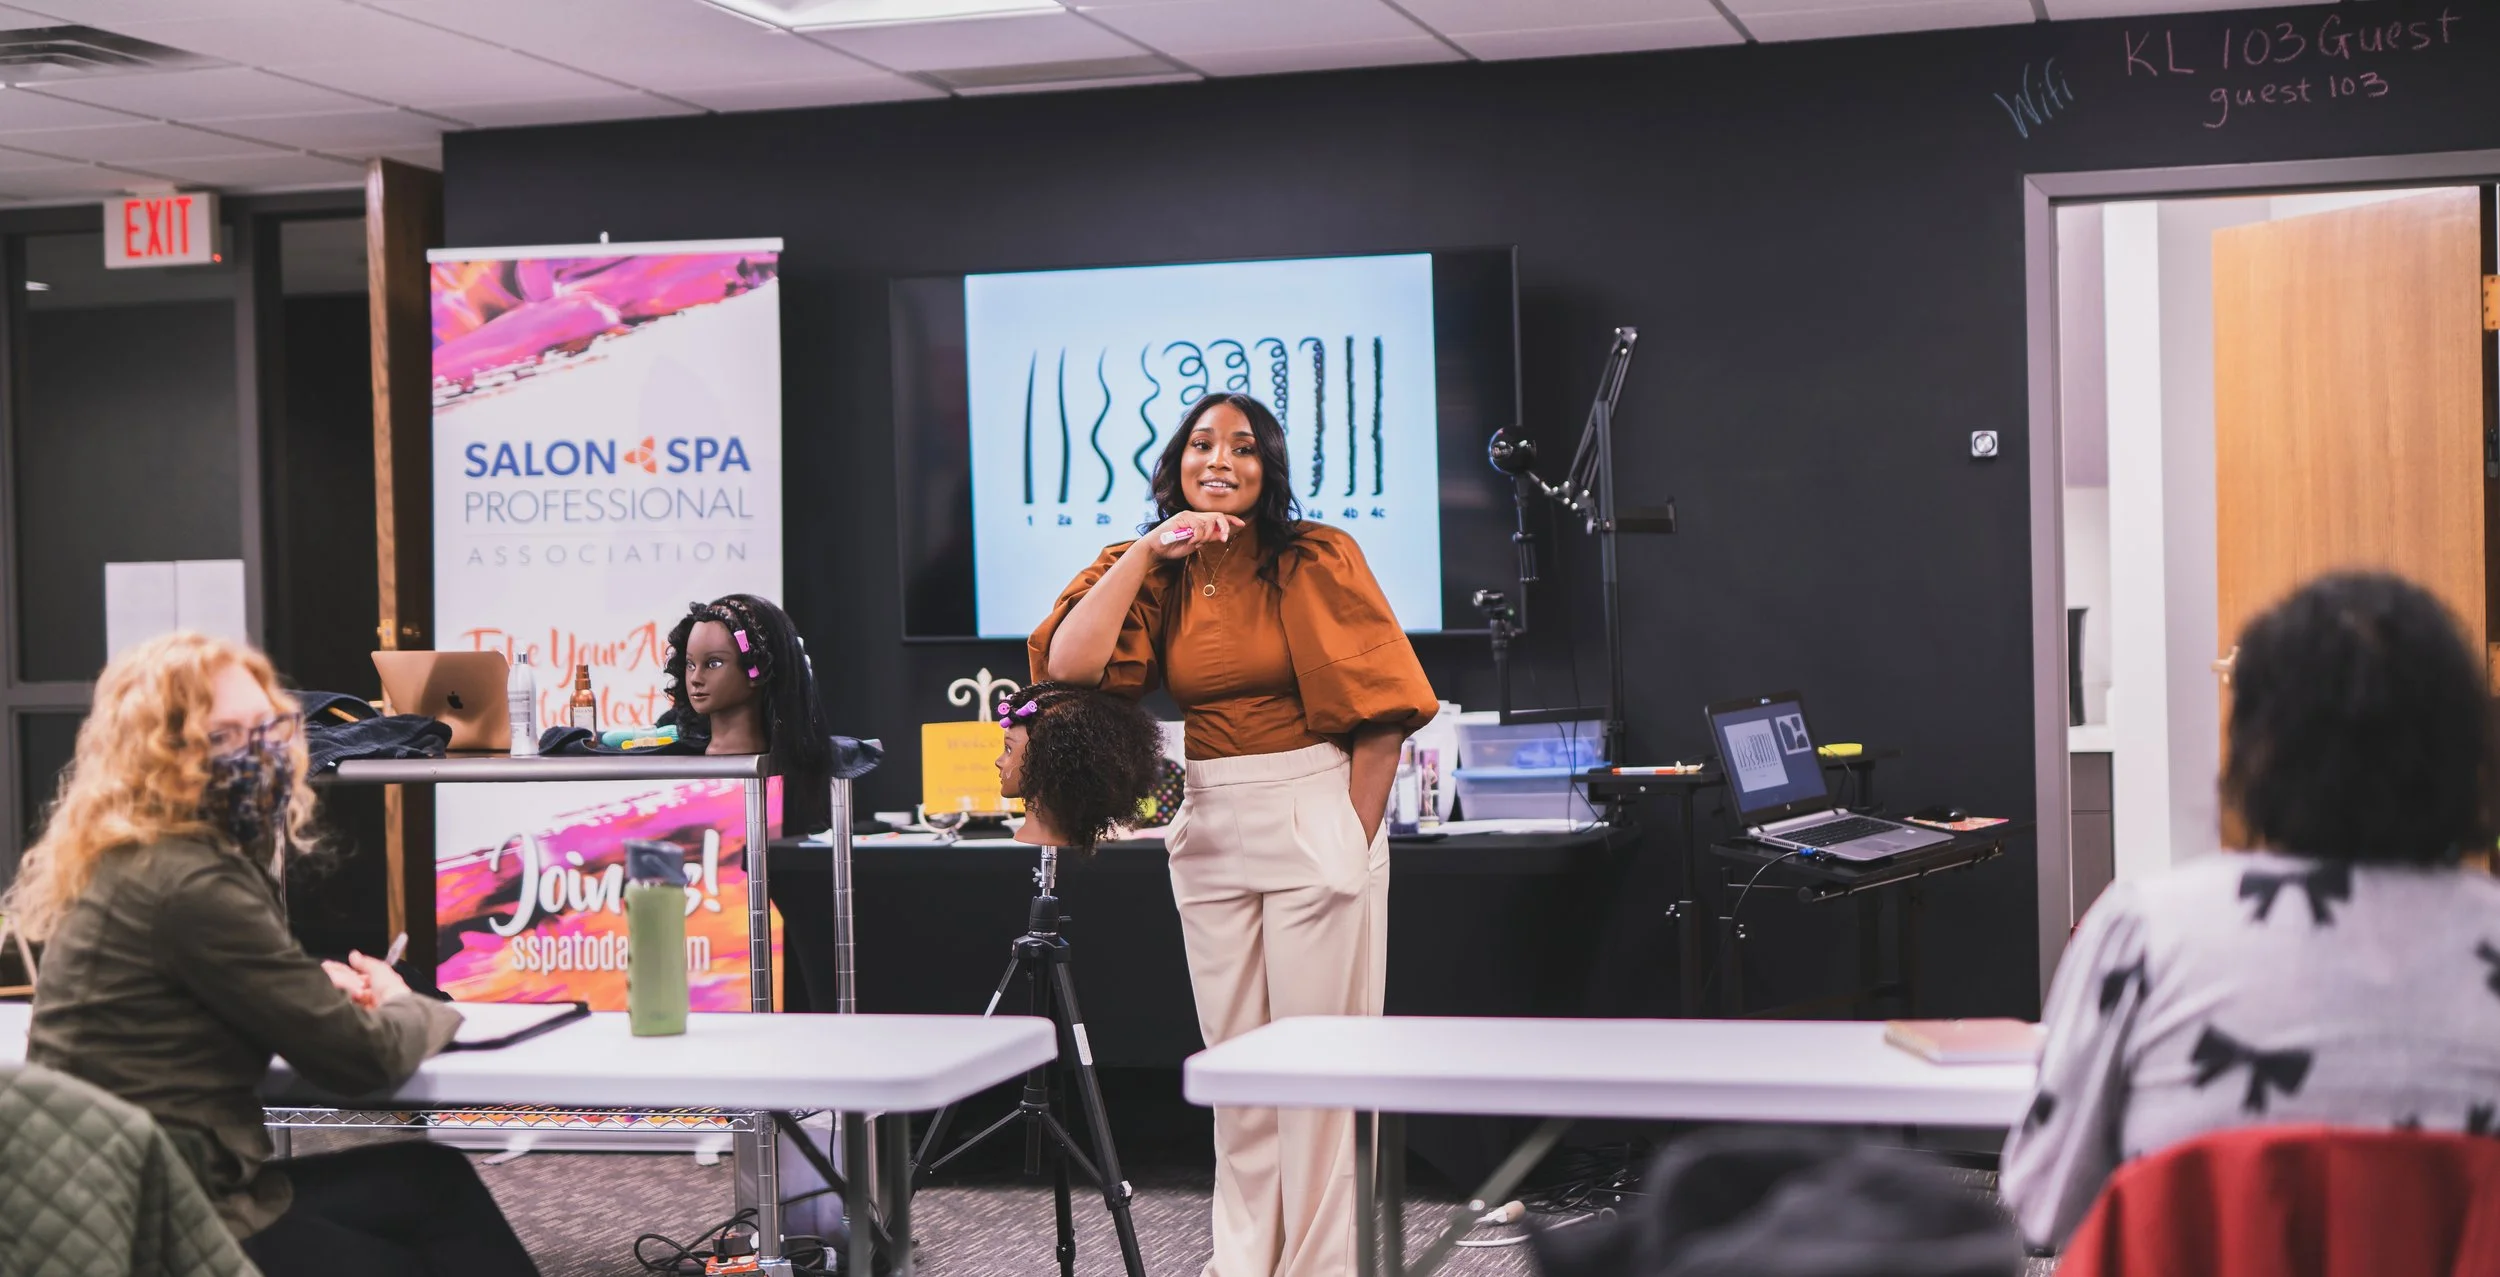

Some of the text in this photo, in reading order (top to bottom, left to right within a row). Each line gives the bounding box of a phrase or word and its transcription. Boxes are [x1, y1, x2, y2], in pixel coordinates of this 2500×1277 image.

[2124, 8, 2463, 76] KL 103 Guest
[1993, 57, 2074, 139] Wifi
[2202, 71, 2389, 129] guest 103
[124, 195, 192, 258] EXIT
[464, 435, 751, 478] SALON SPA
[464, 486, 754, 524] PROFESSIONAL
[1027, 514, 1033, 527] 1
[1057, 513, 1073, 526] 2a
[1096, 512, 1111, 526] 2b
[1371, 506, 1386, 518] 4c
[466, 540, 746, 567] ASSOCIATION
[489, 832, 624, 937] Join
